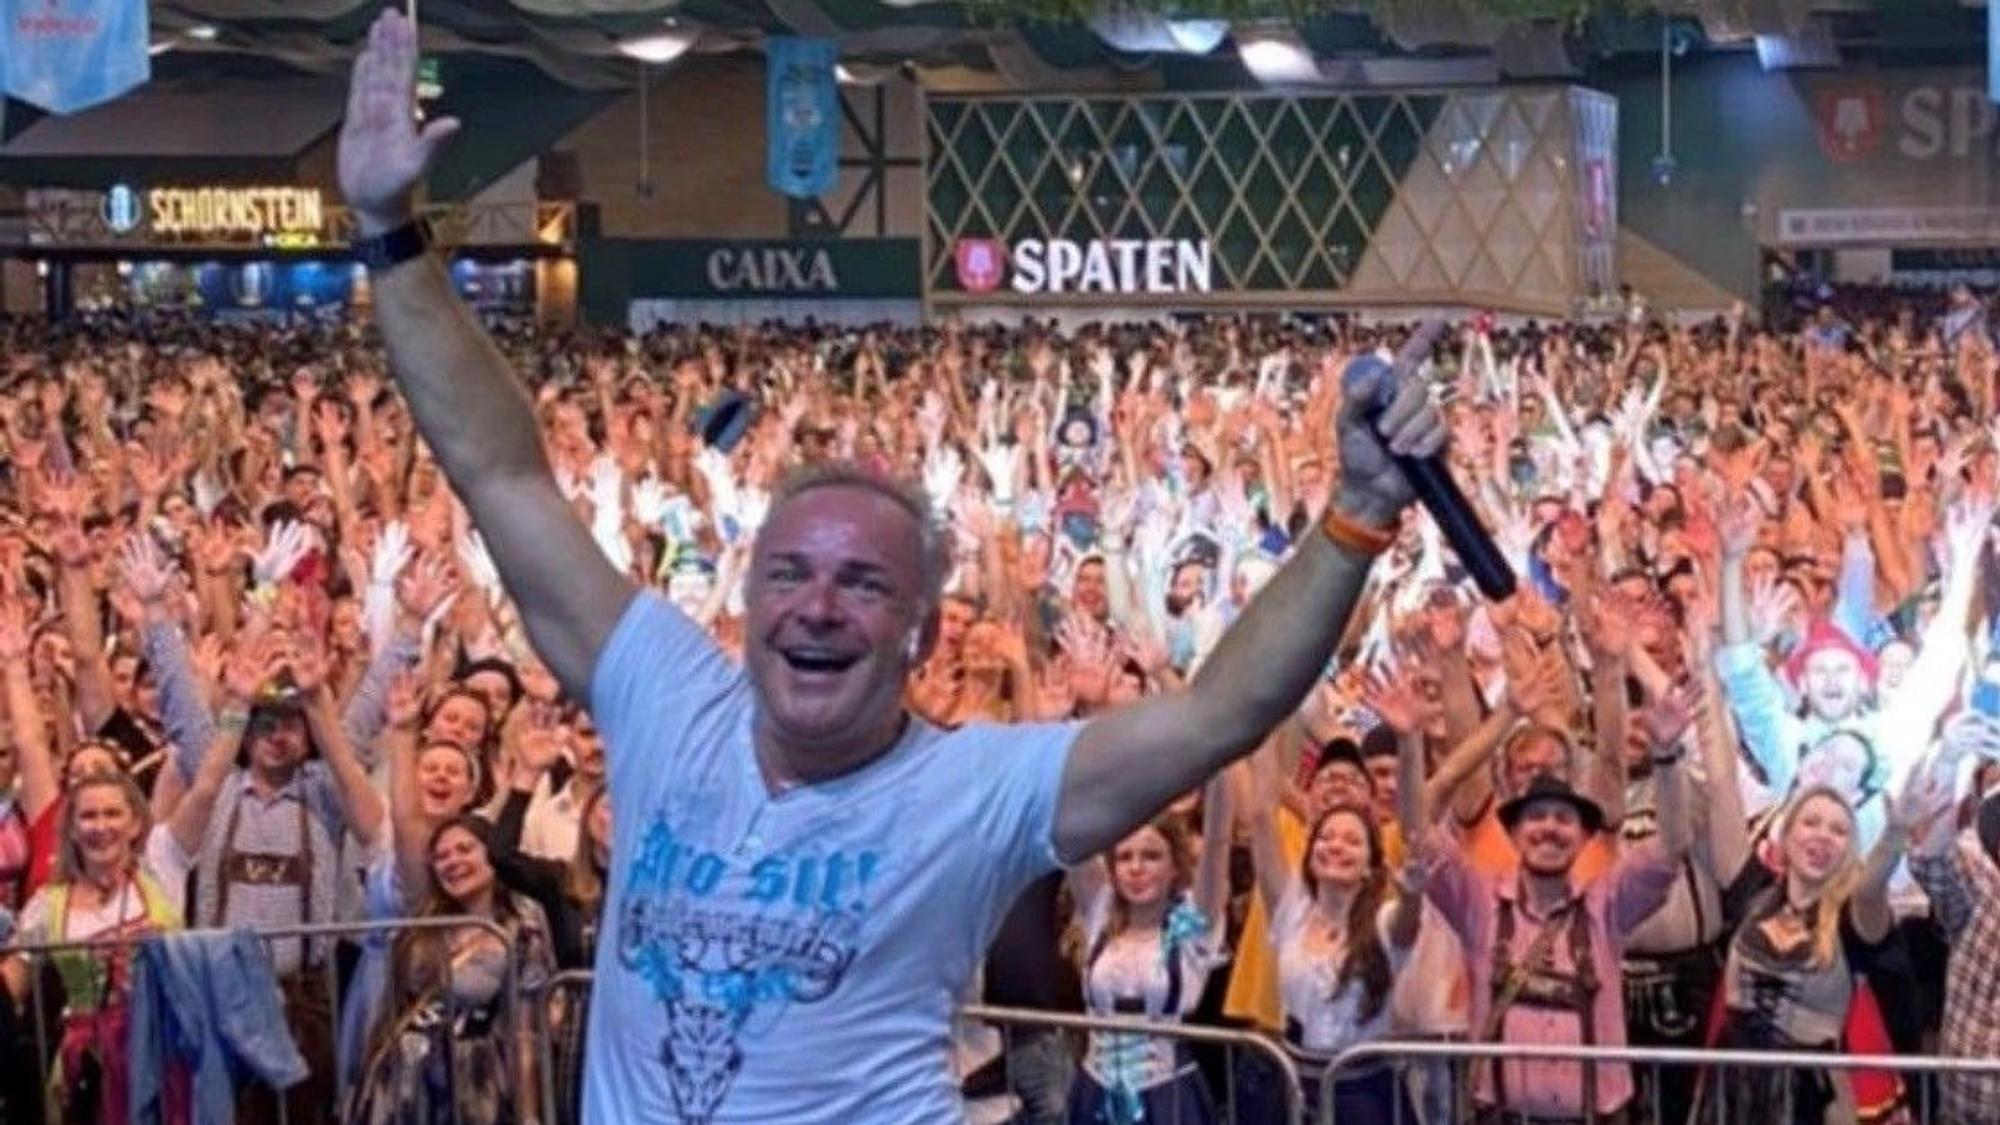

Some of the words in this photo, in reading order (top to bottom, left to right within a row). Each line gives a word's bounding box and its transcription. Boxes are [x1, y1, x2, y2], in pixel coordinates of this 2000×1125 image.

[1900, 86, 2000, 160] SP
[150, 187, 322, 232] SCHORNSTEIN
[706, 248, 837, 290] CAIXA
[1012, 239, 1211, 293] SPATEN
